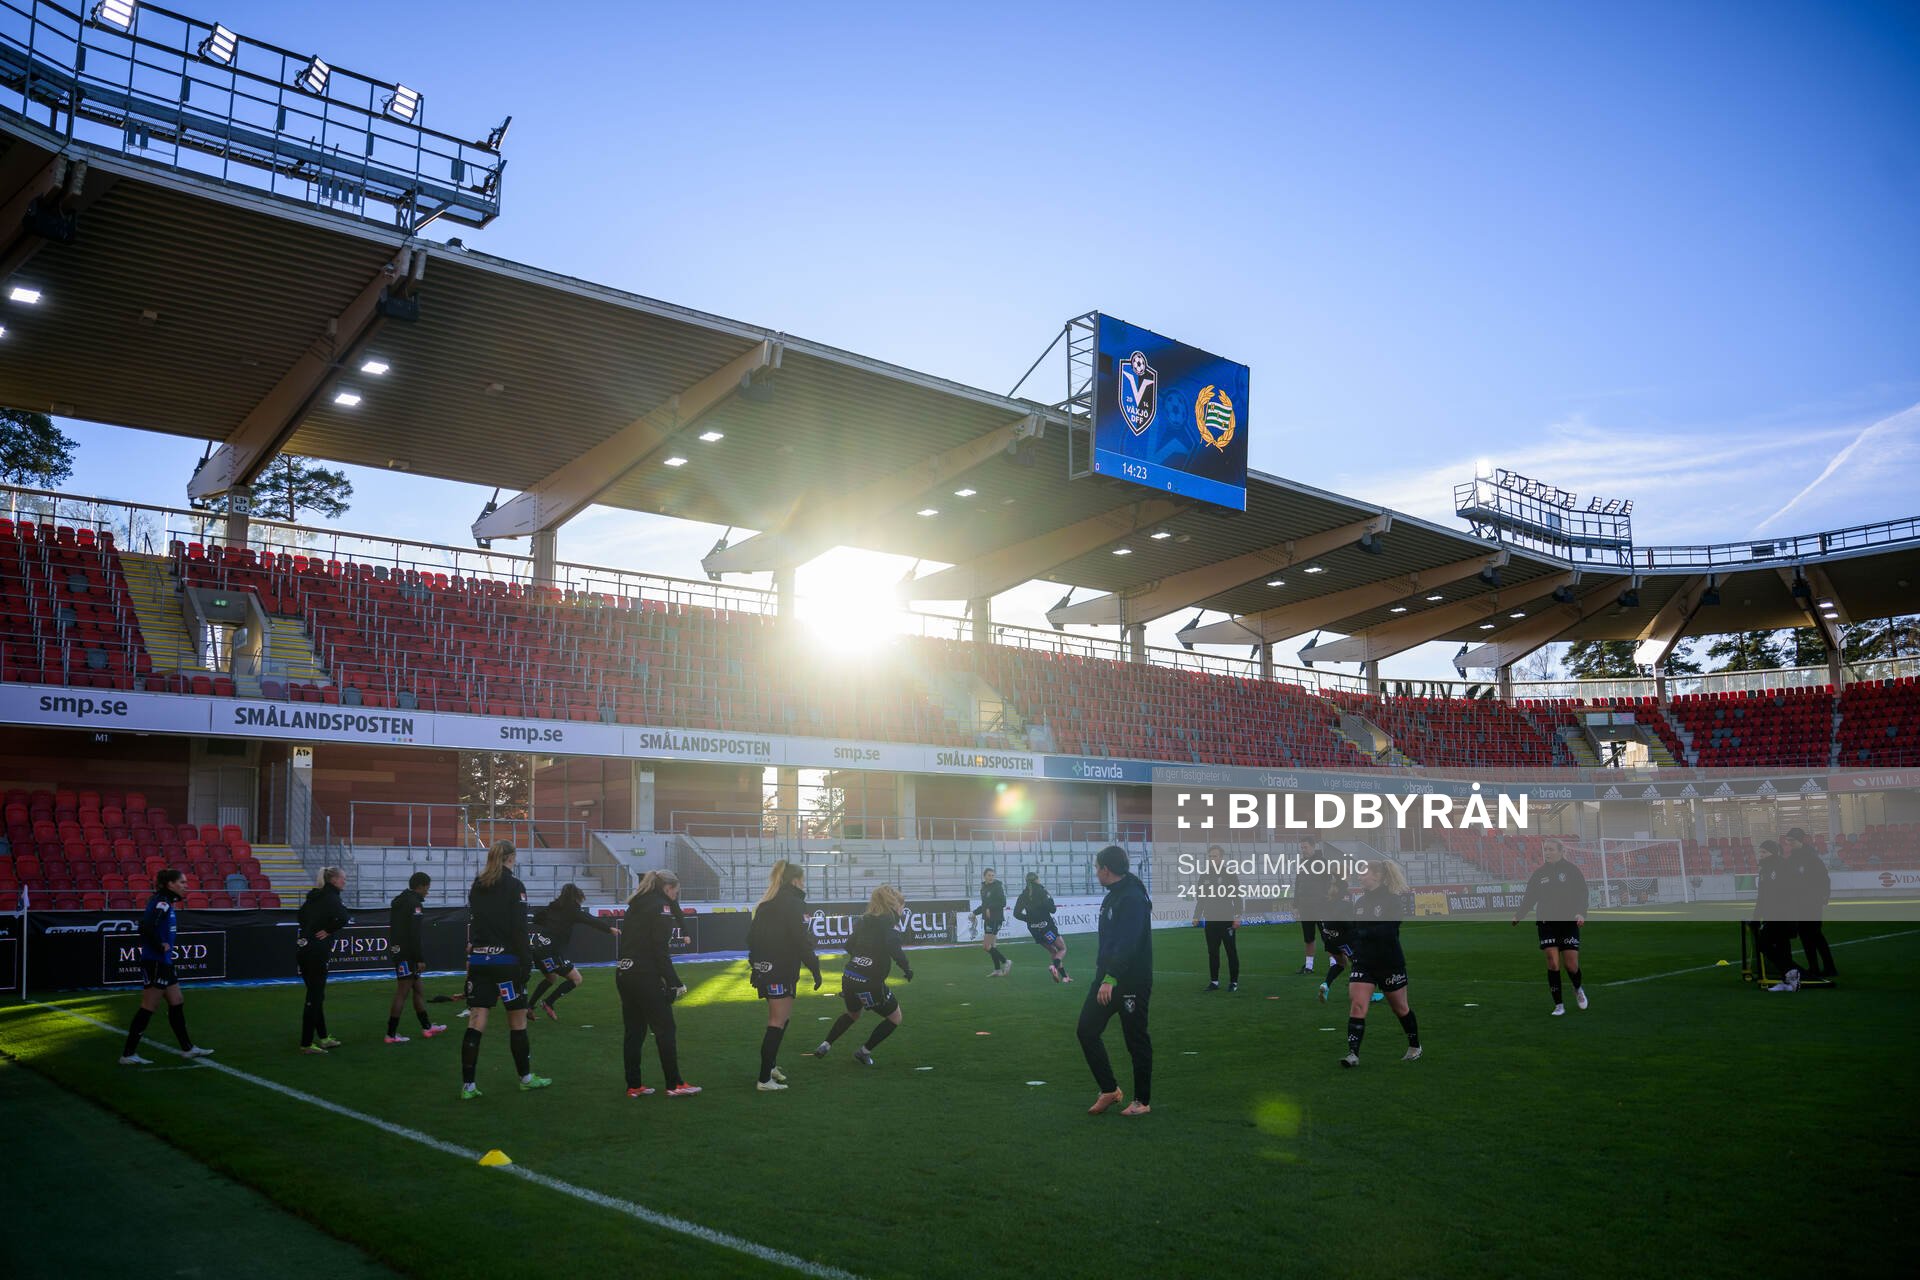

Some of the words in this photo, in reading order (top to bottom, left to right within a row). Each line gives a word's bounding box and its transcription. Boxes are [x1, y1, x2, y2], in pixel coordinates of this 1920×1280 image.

[1130, 414, 1144, 425] DFF
[1122, 462, 1147, 480] 14:23
[40, 695, 128, 718] smp.se
[234, 705, 414, 735] SMÅLANDSPOSTEN
[95, 733, 109, 743] M1
[500, 726, 563, 745] smp.se
[639, 731, 771, 756] SMÅLANDSPOSTEN
[833, 747, 880, 762] smp.se
[1083, 760, 1124, 779] bravida
[1165, 770, 1179, 782] ger
[1181, 768, 1220, 783] fastigheter
[1267, 773, 1298, 788] bravida
[1409, 781, 1434, 795] bravida
[1869, 775, 1902, 786] VISMA
[1540, 787, 1572, 799] bravida
[1461, 896, 1487, 909] TELECOM
[1492, 896, 1505, 908] BRA
